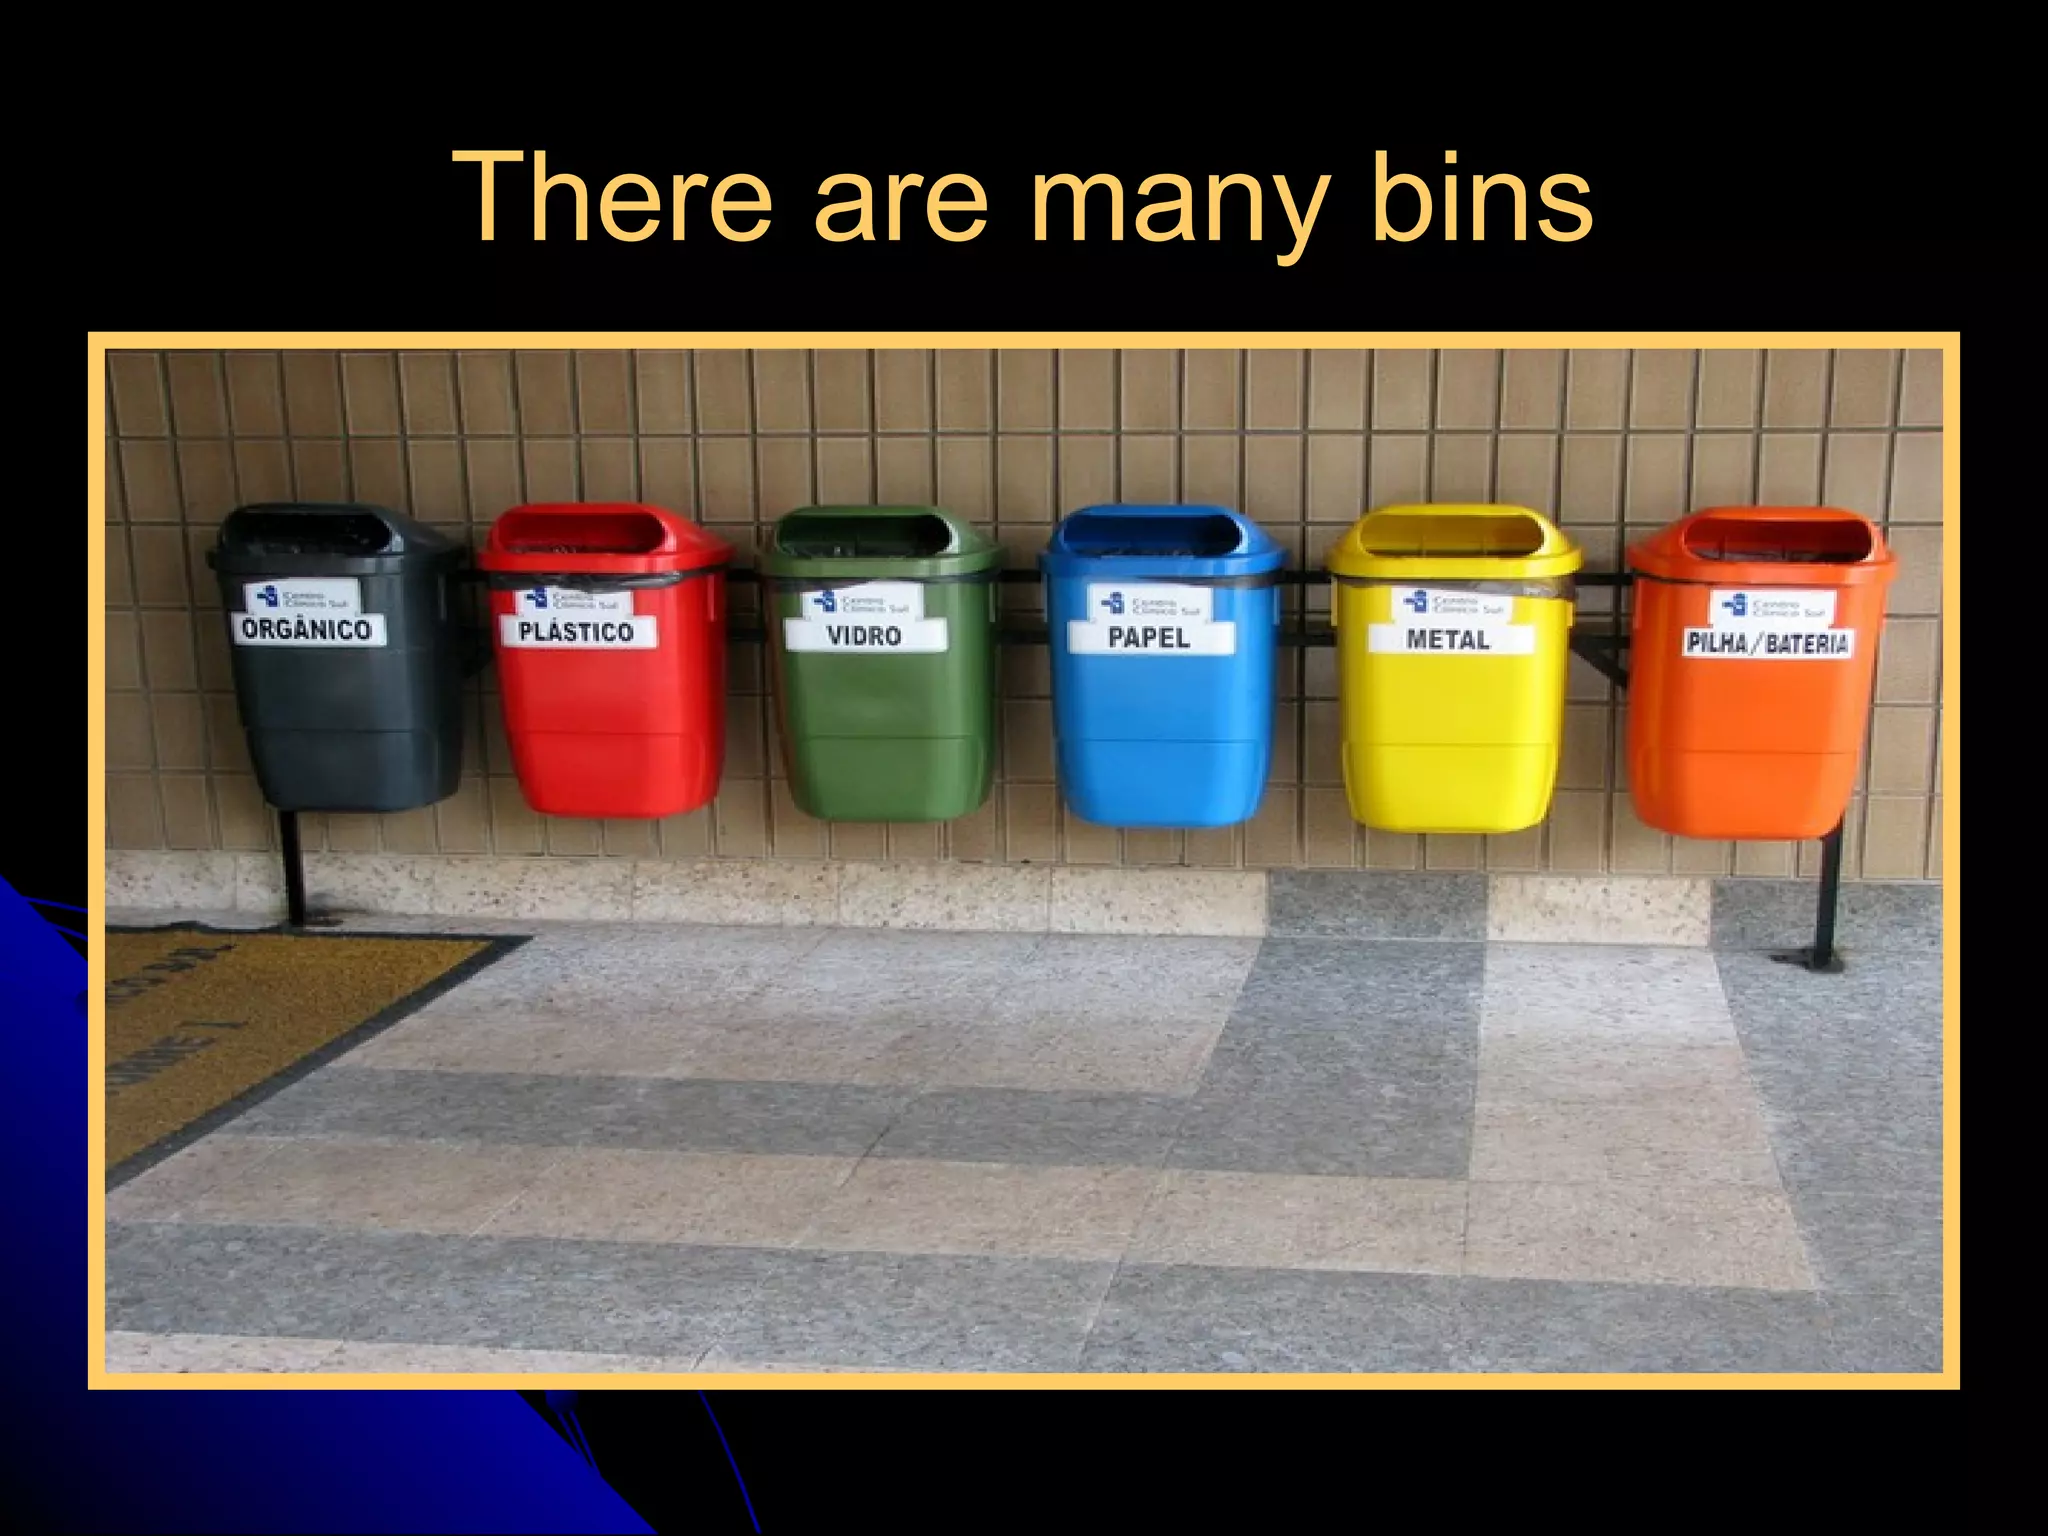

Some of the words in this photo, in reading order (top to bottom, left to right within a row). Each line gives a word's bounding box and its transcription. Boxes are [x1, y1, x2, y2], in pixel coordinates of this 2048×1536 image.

[242, 613, 372, 640] ORGÂNICO
[519, 617, 634, 642] PLÁSTICO
[826, 625, 902, 646] VIDRO
[1108, 626, 1191, 648] PAPEL
[1406, 628, 1491, 650] METAL
